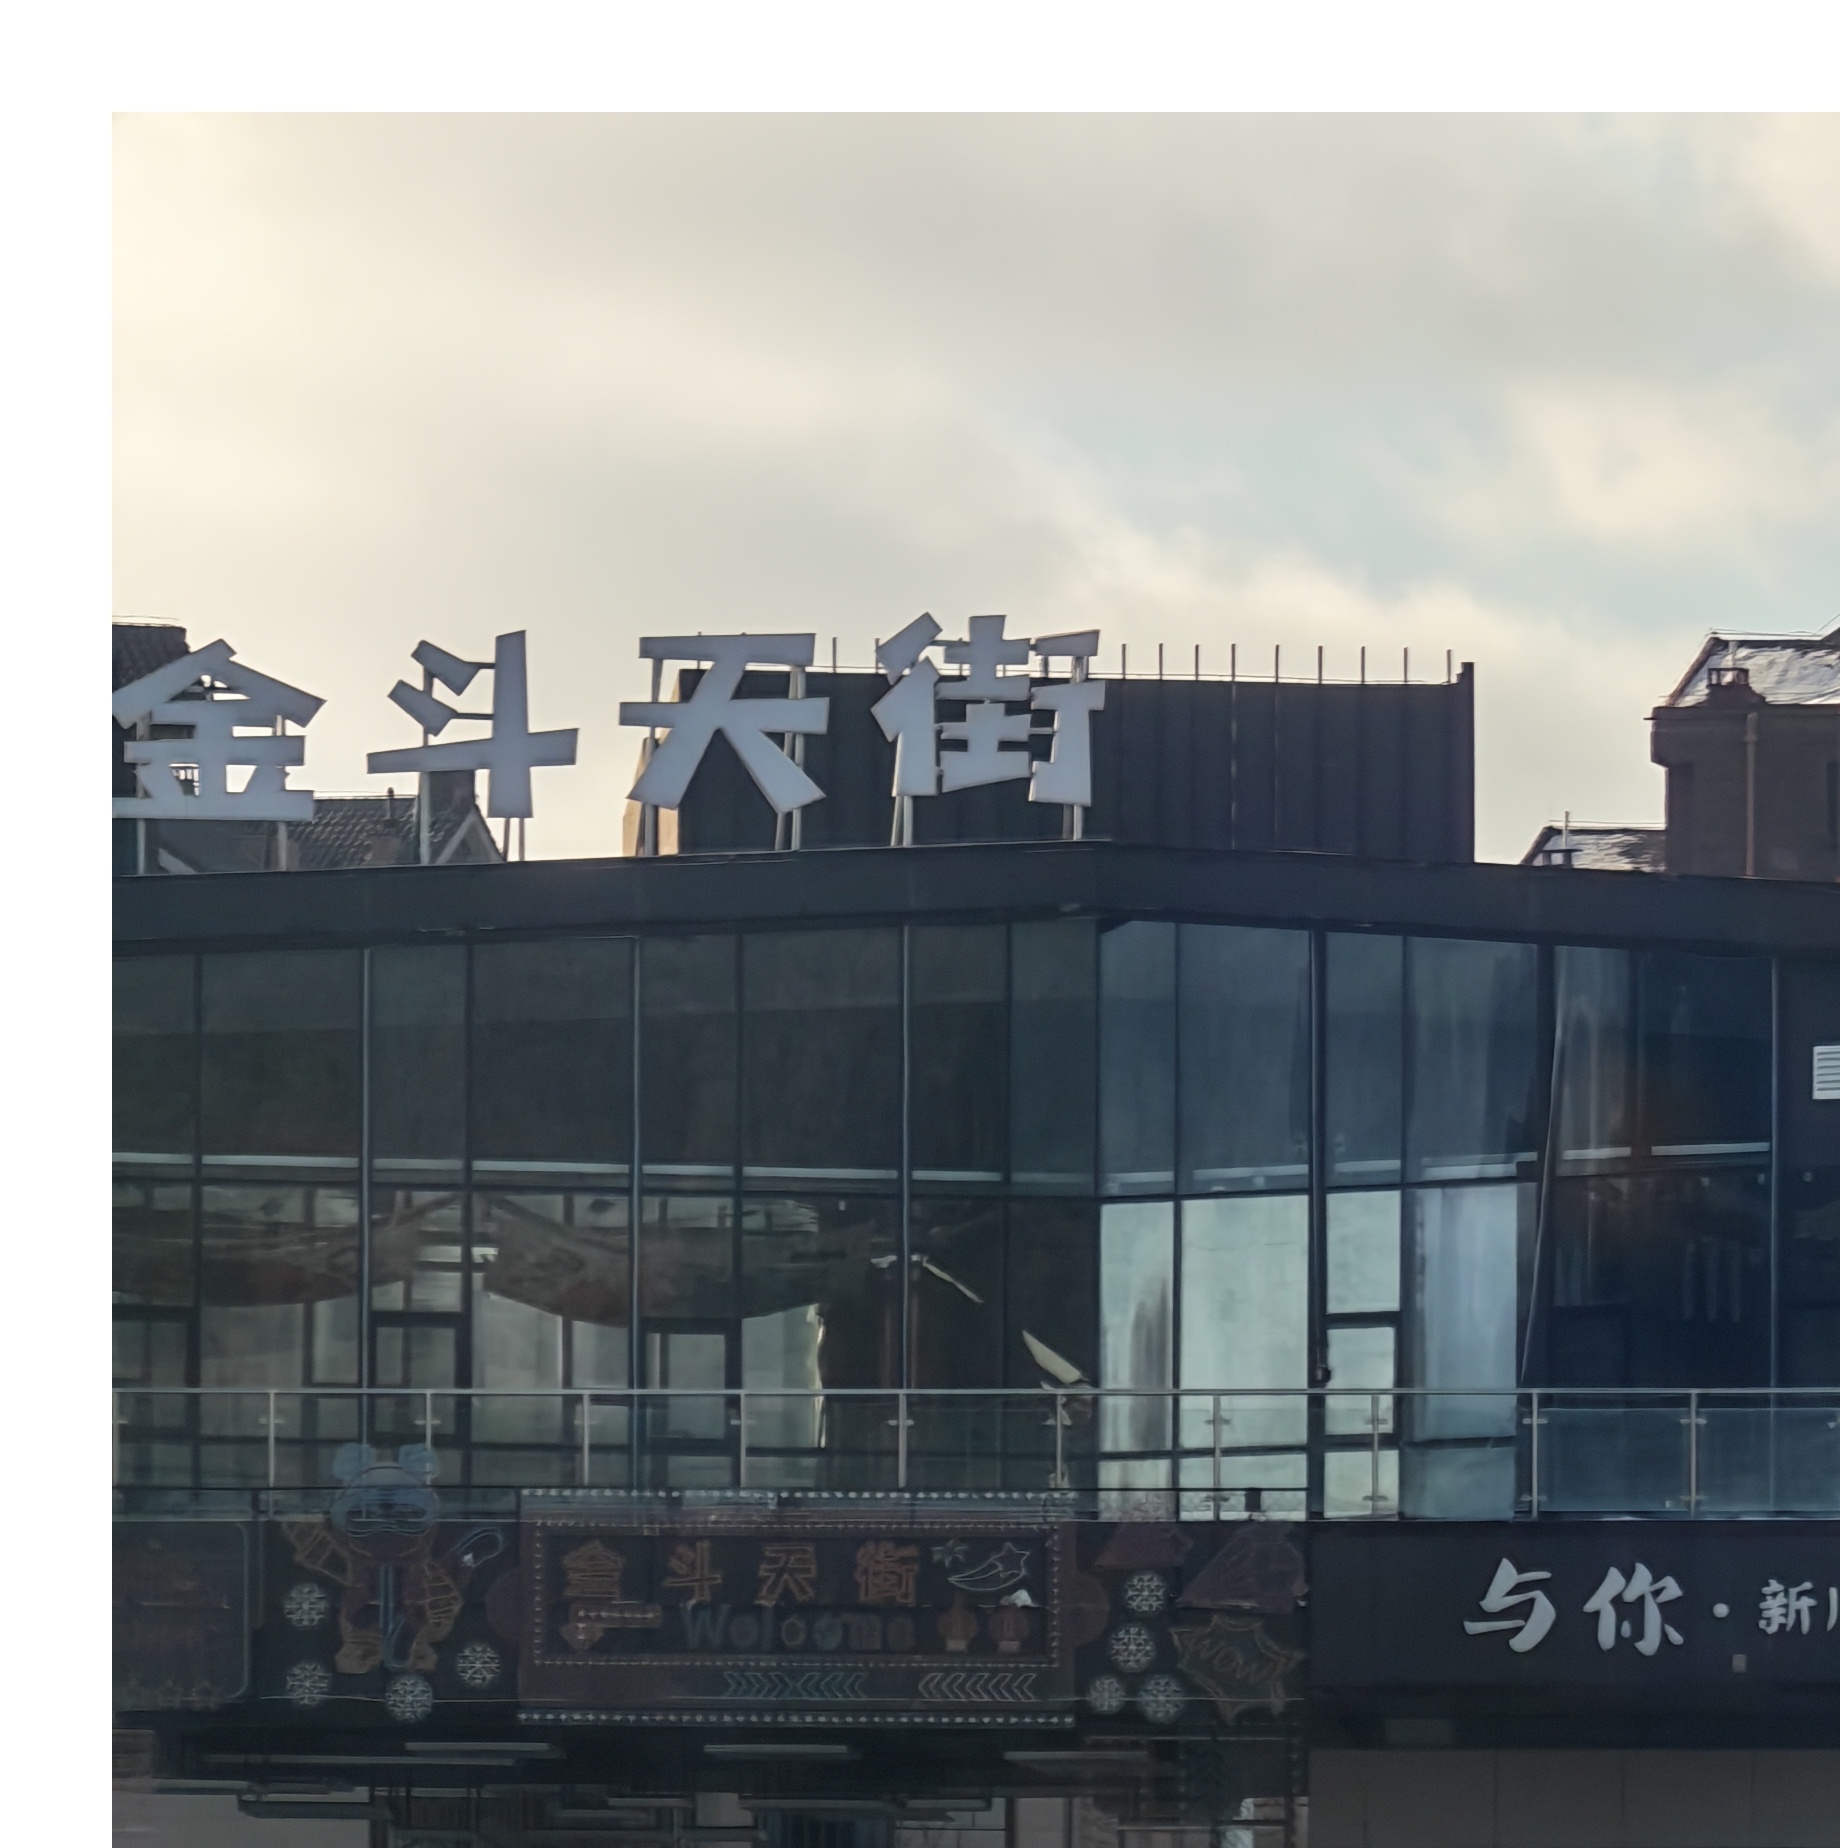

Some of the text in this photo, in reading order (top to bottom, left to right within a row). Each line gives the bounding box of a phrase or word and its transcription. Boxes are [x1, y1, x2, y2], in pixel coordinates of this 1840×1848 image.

[112, 612, 1105, 821] 金斗天街
[561, 1538, 920, 1606] 金斗天街
[681, 1602, 917, 1653] Welcome
